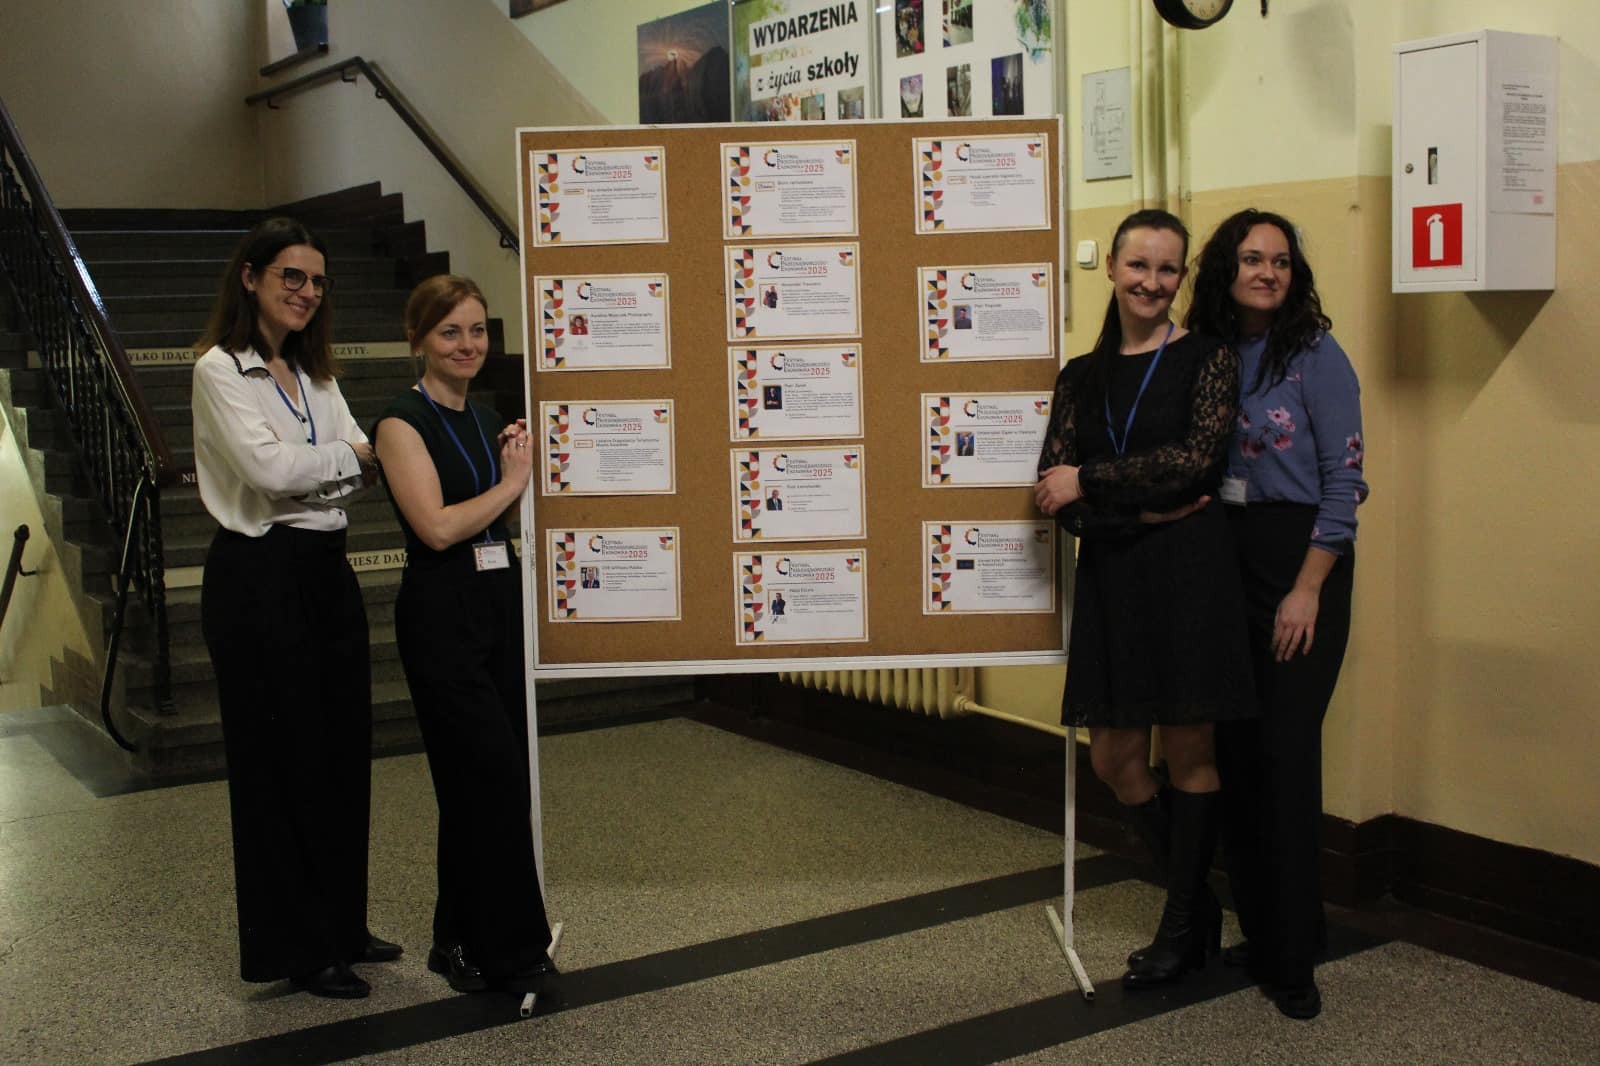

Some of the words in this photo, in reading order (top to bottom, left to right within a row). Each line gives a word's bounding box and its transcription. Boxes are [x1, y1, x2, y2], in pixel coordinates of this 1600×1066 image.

[753, 1, 858, 48] WYDARZENIA
[769, 65, 801, 95] życia
[807, 51, 859, 81] szkoły
[996, 158, 1016, 166] 2025
[804, 165, 824, 173] 2025
[807, 266, 828, 274] 2025
[1000, 288, 1020, 296] 2025
[616, 297, 637, 305] 2025
[335, 346, 369, 355] CZYTY.
[128, 351, 158, 361] YLKO
[161, 351, 190, 362] IDĄC
[810, 368, 830, 376] 2025
[1003, 415, 1023, 423] 2025
[812, 469, 833, 477] 2025
[182, 472, 195, 484] NI
[1004, 543, 1024, 551] 2025
